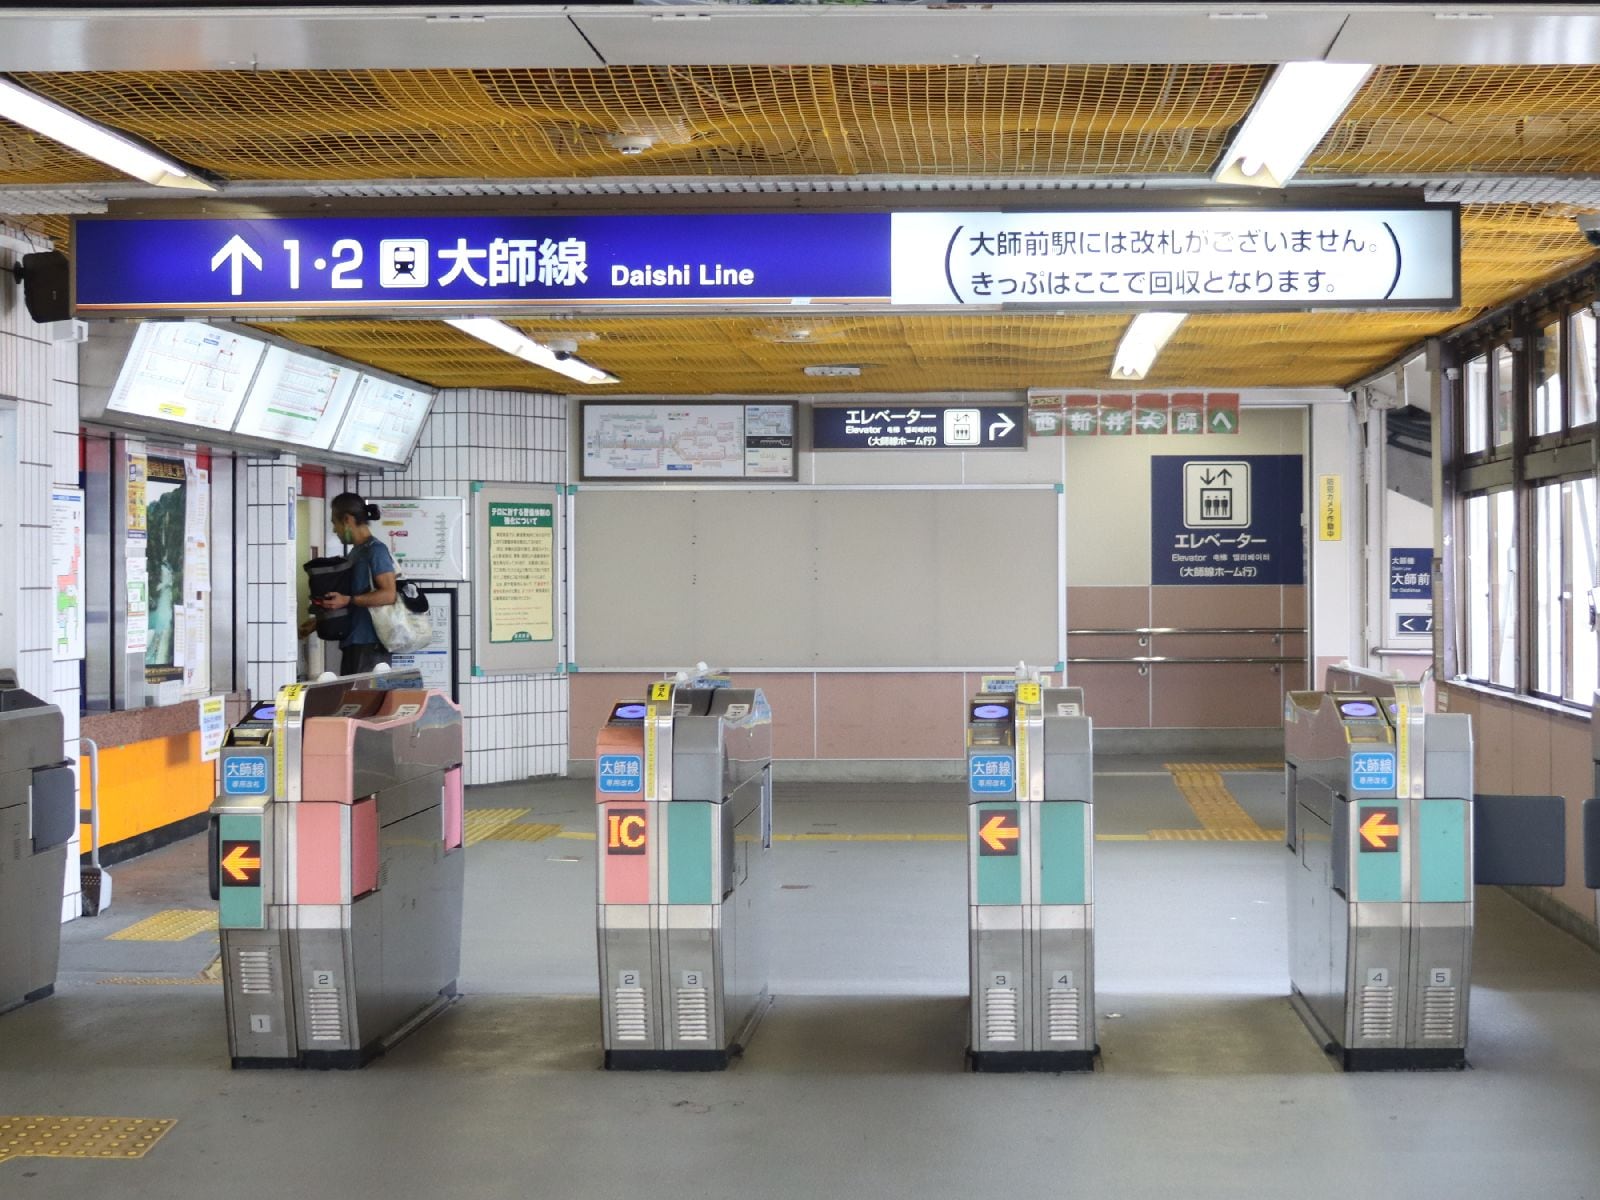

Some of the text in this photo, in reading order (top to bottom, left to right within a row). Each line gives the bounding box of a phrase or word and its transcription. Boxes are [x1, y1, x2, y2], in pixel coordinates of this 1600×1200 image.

[969, 229, 1378, 257] 大師前駅には改札がございません。
[437, 237, 589, 287] 大師線
[611, 264, 690, 286] Daishi
[699, 264, 755, 286] Line
[970, 269, 1335, 296] きっぷはここで回収となります。
[846, 408, 937, 425] エレベーター
[1174, 533, 1267, 549] エレベーター
[1171, 553, 1208, 562] Elevator
[1391, 572, 1431, 586] 大師前
[227, 761, 265, 776] 大師線
[601, 760, 640, 775] 大師線
[973, 760, 1011, 776] 大師線
[1354, 757, 1393, 772] 大師線
[608, 815, 645, 848] IC
[318, 974, 329, 985] 2
[624, 974, 635, 985] 2
[687, 974, 698, 985] 3
[995, 975, 1007, 985] 3
[1057, 975, 1068, 984] 4
[1372, 972, 1383, 982] 4
[1435, 972, 1446, 983] 5
[257, 1018, 264, 1029] 1
